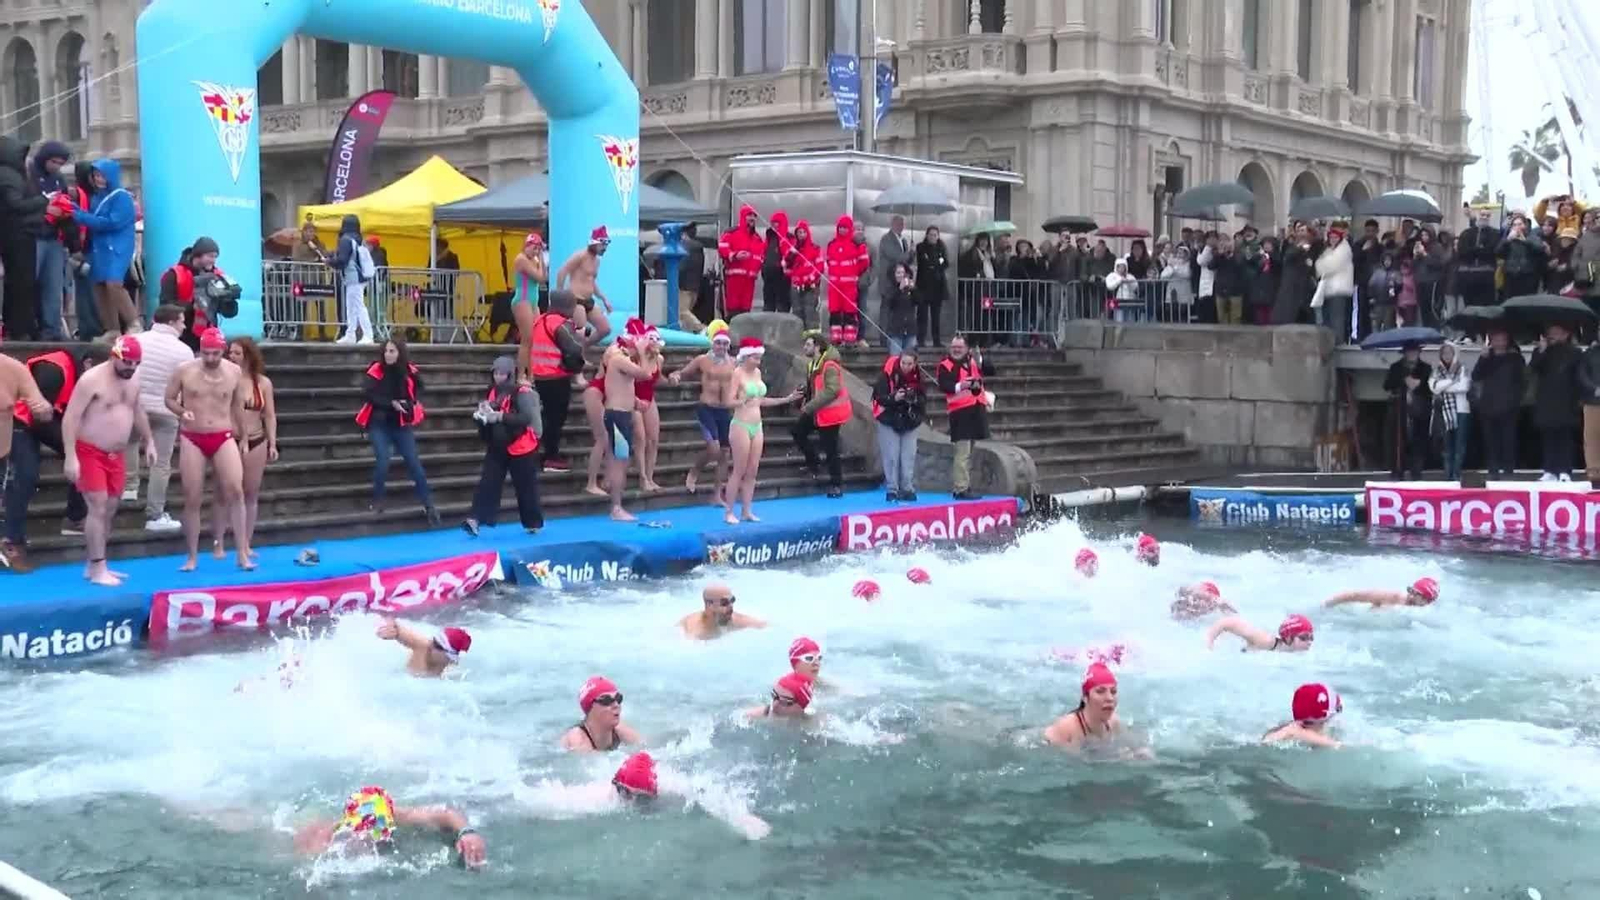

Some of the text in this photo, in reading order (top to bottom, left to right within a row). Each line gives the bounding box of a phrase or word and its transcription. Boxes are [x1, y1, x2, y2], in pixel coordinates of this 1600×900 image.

[332, 128, 358, 204] RCELONA
[1226, 502, 1351, 521] Club Natació
[735, 535, 833, 565] Club Natació
[1, 618, 133, 659] Natació
